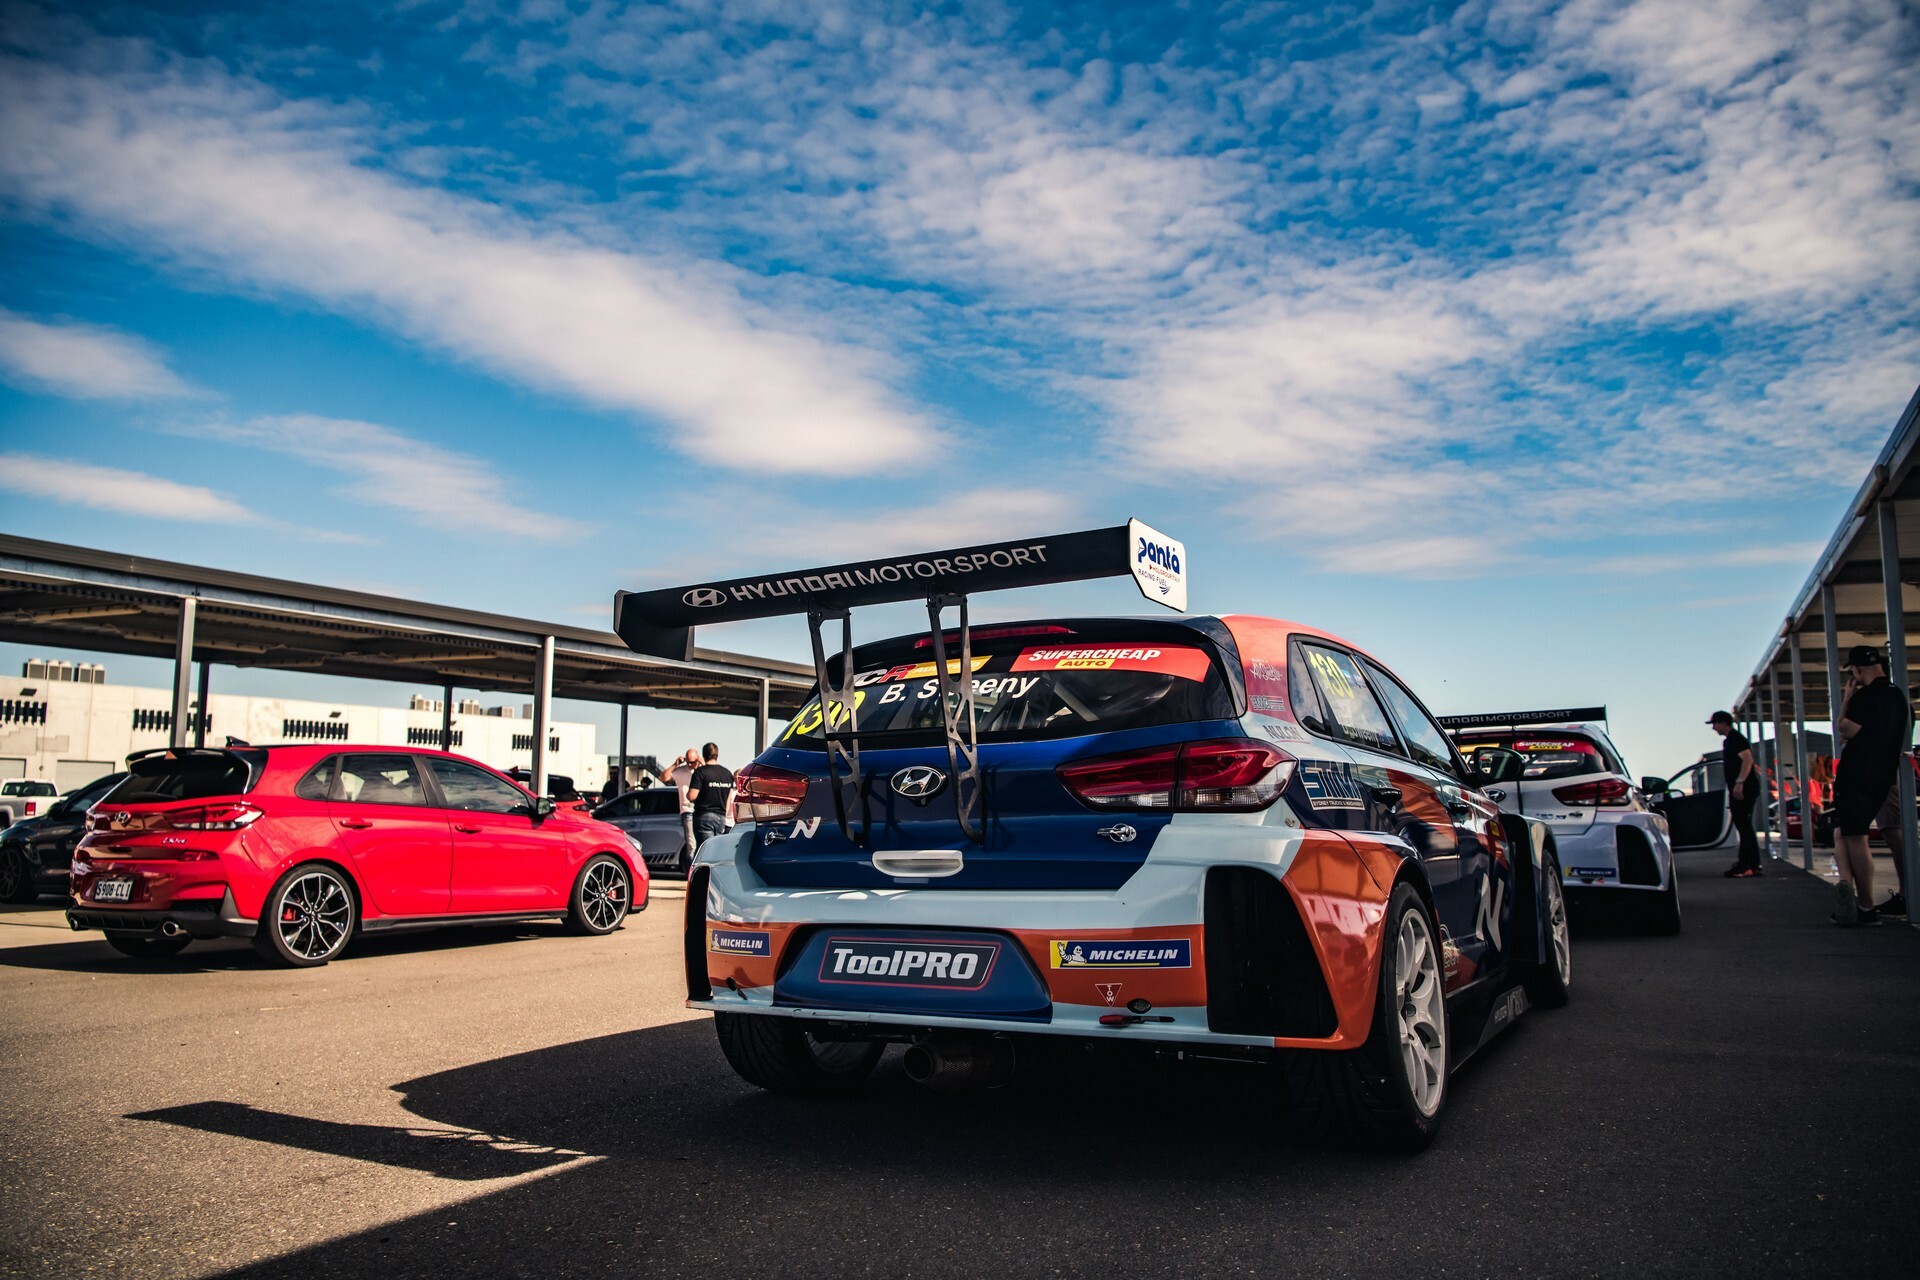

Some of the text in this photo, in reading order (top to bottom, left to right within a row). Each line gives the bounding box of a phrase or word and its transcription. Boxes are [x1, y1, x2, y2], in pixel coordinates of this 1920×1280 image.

[729, 544, 1048, 602] HYUNDAI MOTORSPORT
[1137, 568, 1167, 587] RACING FUEL
[1028, 649, 1162, 662] SUPERCHEAP
[1307, 650, 1355, 699] 130
[878, 676, 1040, 704] B. Seeny
[1485, 710, 1573, 723] MOTORSPORT
[720, 938, 763, 949] MICHELIN
[1089, 948, 1179, 961] MICHELIN
[833, 948, 980, 980] ToolPRO
[1106, 984, 1115, 1002] TOW
